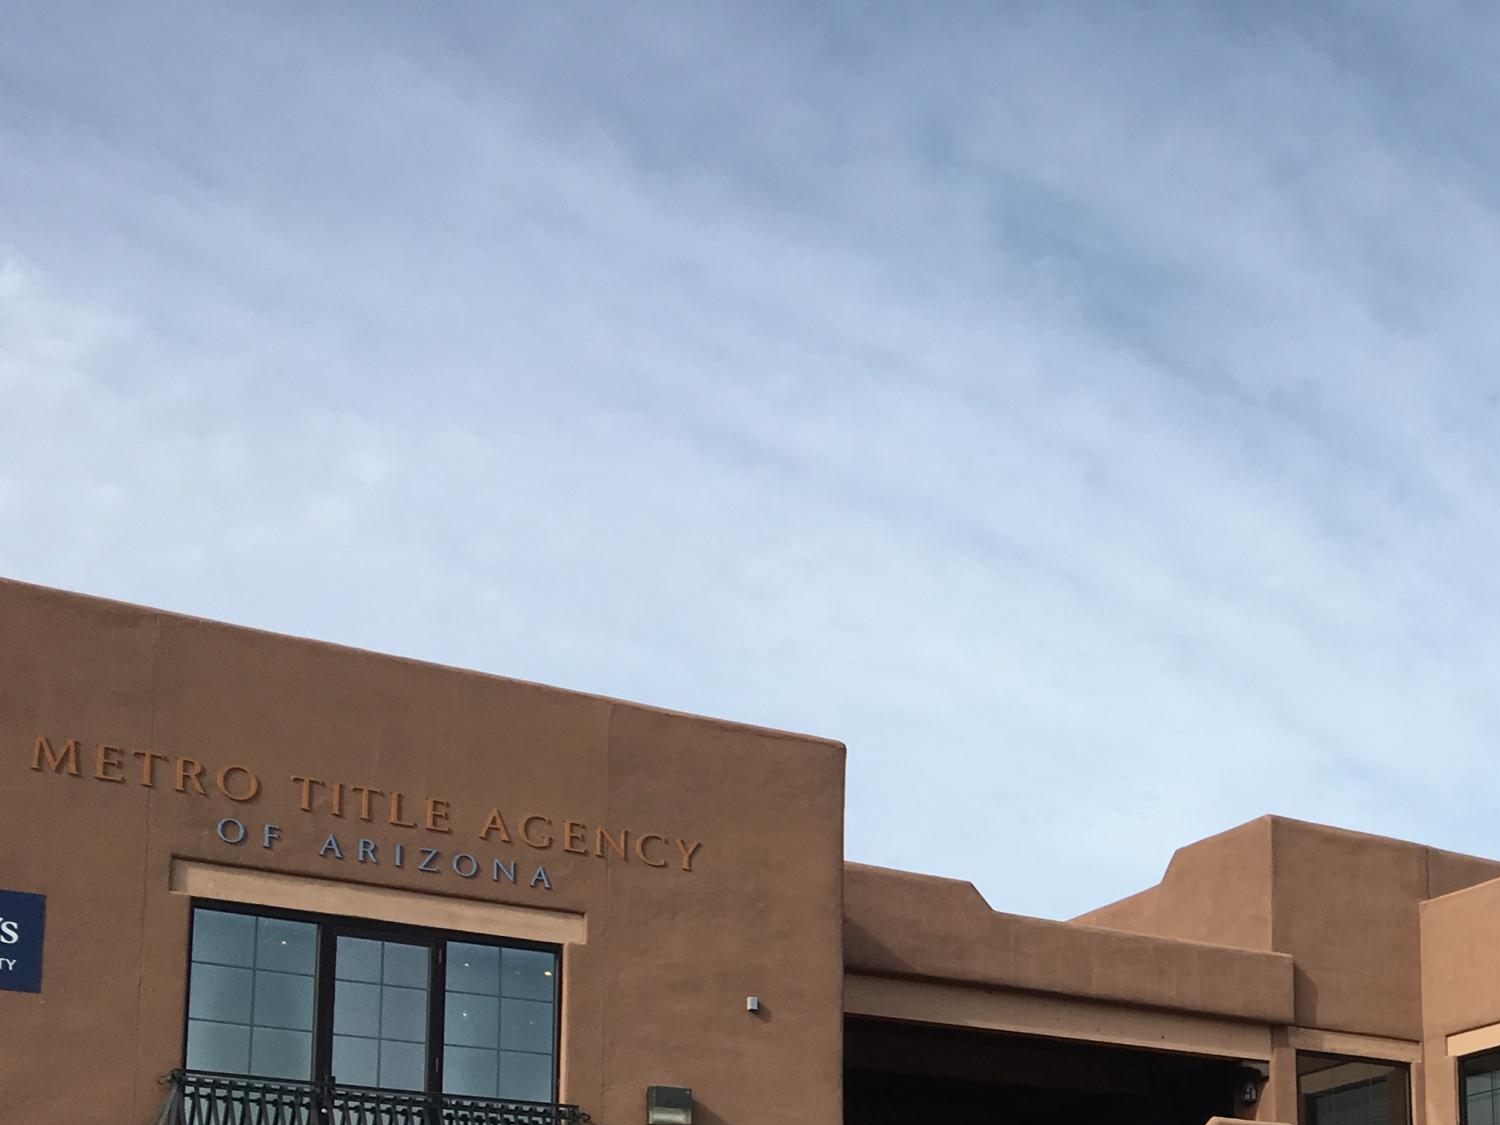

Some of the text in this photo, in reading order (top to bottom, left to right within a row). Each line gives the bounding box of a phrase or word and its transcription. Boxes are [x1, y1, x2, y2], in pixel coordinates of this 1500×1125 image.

[29, 735, 703, 871] METRO TITLE AGENCY
[217, 817, 554, 890] OF ARIZONA
